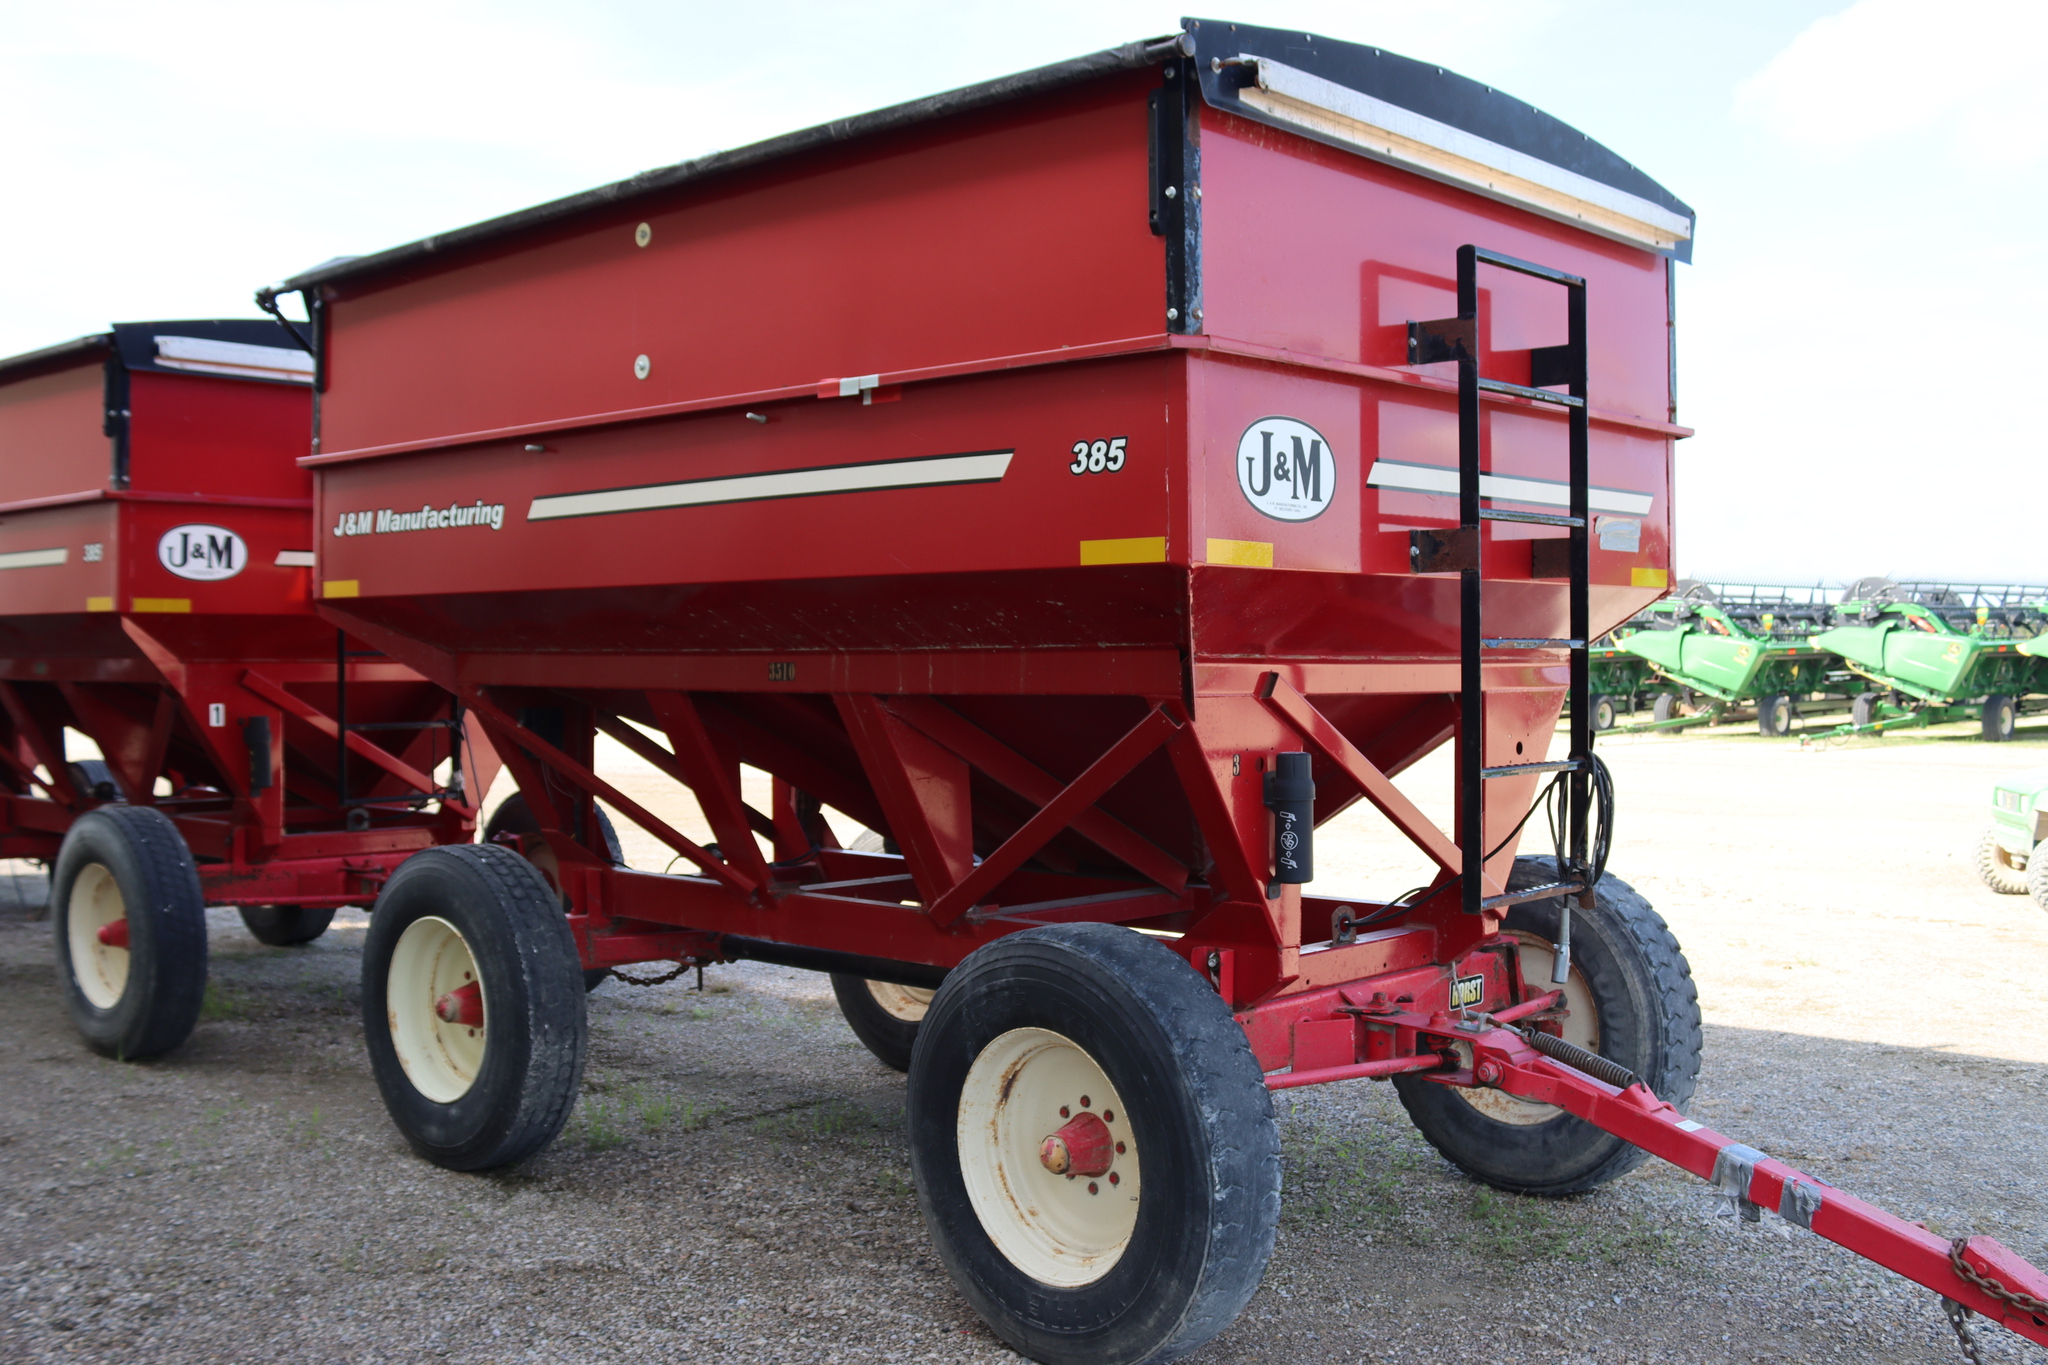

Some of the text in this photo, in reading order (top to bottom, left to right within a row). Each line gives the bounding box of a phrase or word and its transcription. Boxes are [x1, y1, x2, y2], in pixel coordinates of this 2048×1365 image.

[1069, 436, 1128, 476] 385
[1245, 430, 1323, 502] J&M
[333, 499, 504, 537] J&M Manufacturing
[166, 532, 234, 571] J&M
[768, 662, 796, 681] 3510
[1233, 754, 1240, 776] 3
[1451, 978, 1482, 1006] HORST
